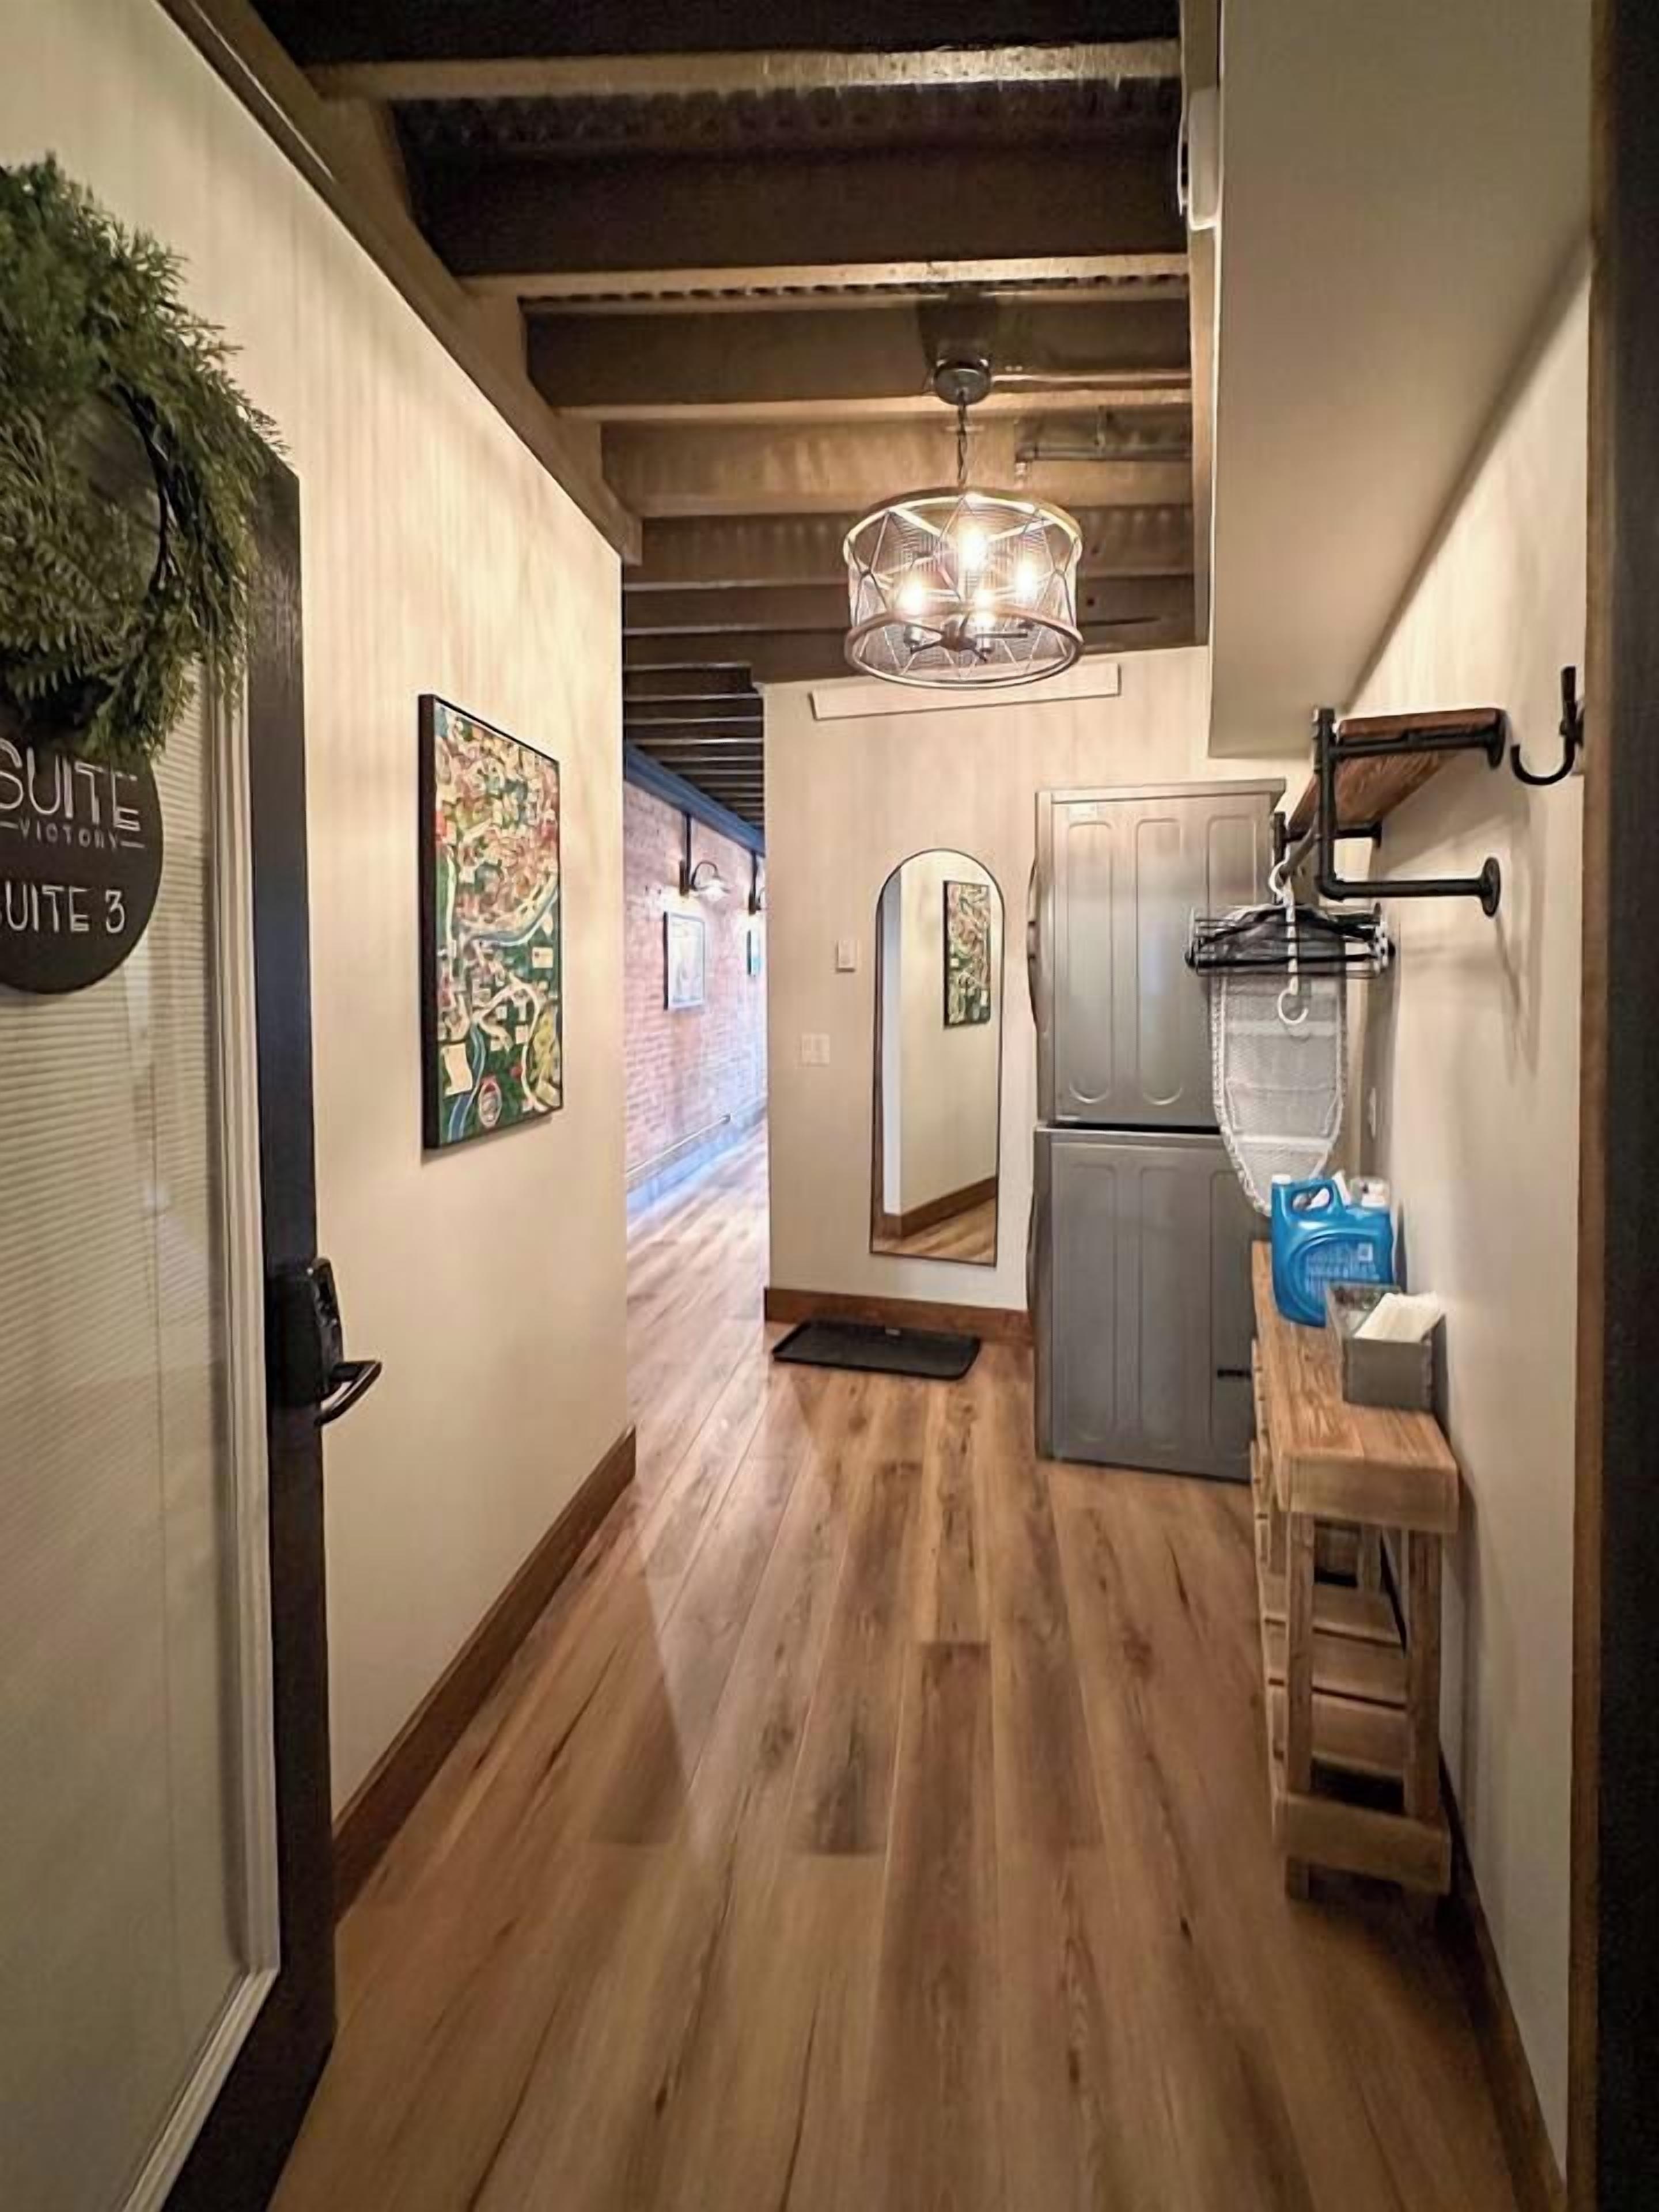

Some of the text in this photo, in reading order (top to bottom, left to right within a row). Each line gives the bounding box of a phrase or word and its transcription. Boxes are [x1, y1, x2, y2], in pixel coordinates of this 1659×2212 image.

[20, 818, 117, 850] VICTORY
[0, 880, 125, 933] UITE 3
